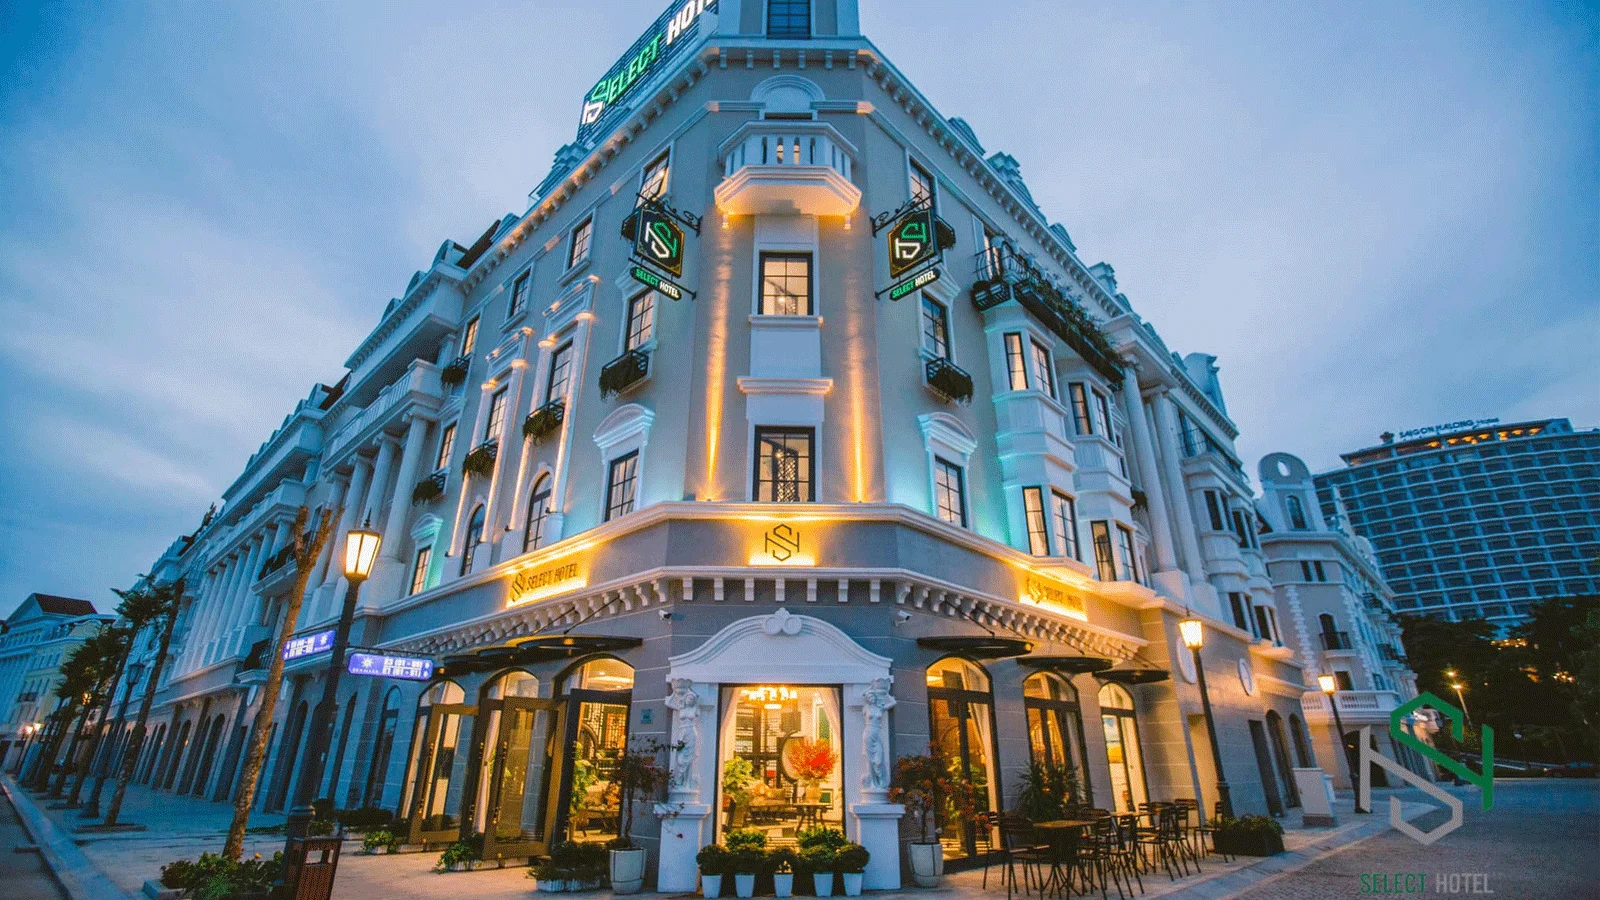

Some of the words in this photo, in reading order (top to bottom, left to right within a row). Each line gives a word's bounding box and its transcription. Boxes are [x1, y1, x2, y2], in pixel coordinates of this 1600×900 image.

[635, 269, 659, 287] SELECT
[659, 281, 679, 298] HOTEL
[892, 280, 914, 298] SELECT
[915, 270, 936, 287] HOTEL
[1399, 426, 1434, 438] SAIGON
[1436, 419, 1474, 433] HALONG
[527, 571, 552, 591] SELECT
[554, 563, 578, 581] HOTEL
